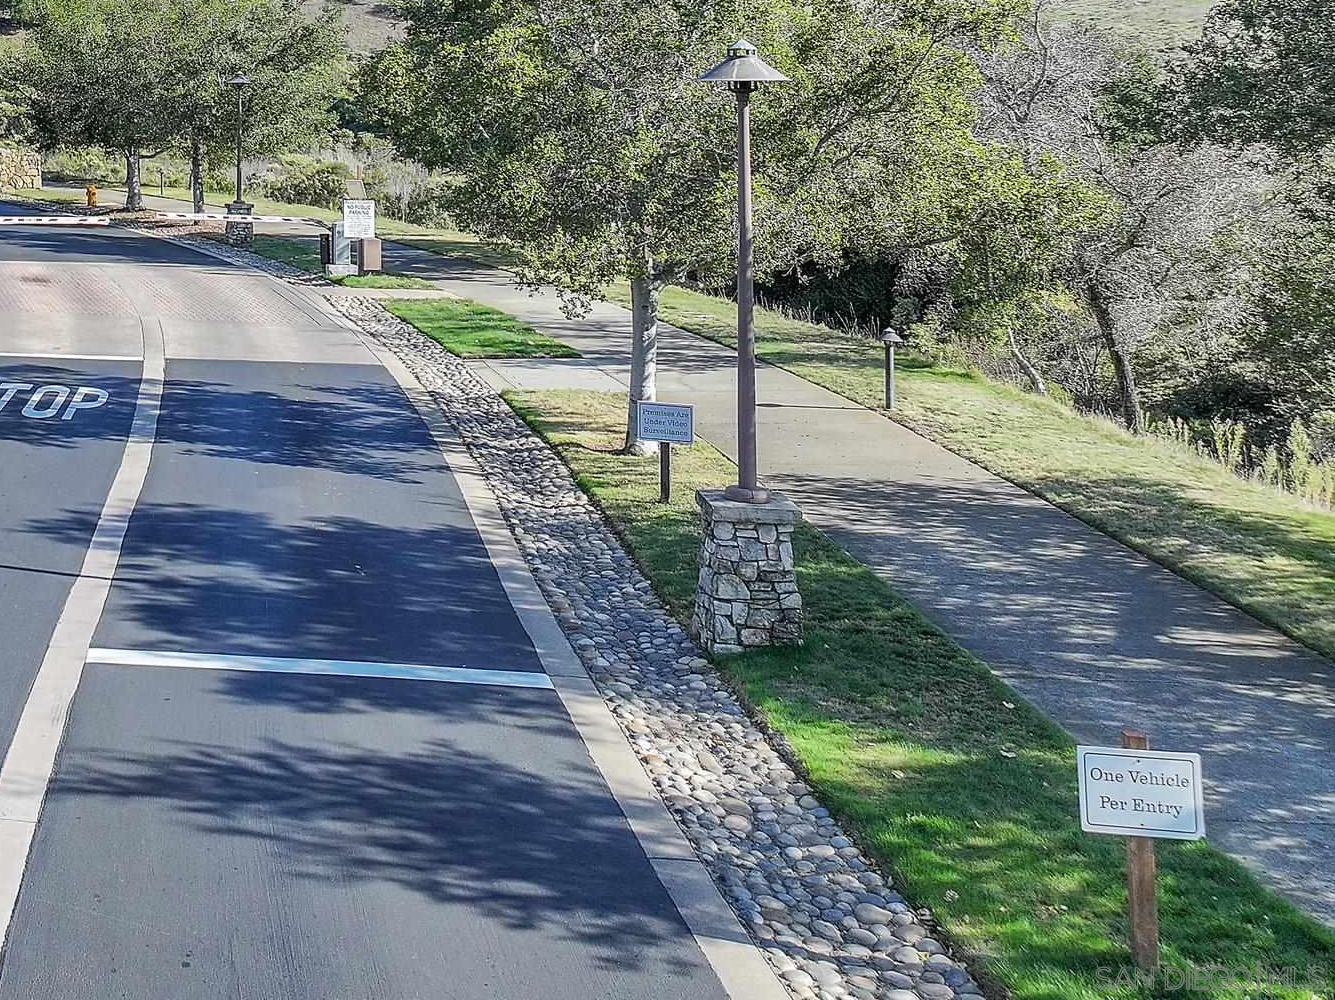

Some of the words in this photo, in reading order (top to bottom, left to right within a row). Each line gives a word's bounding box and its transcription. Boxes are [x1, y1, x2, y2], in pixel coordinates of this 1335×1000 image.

[644, 417, 666, 426] Under
[667, 419, 688, 428] Video
[643, 427, 689, 436] Surveillance
[1090, 767, 1124, 783] One
[1128, 770, 1190, 788] Vehicle
[1099, 795, 1127, 810] Per
[1132, 798, 1183, 819] Entry
